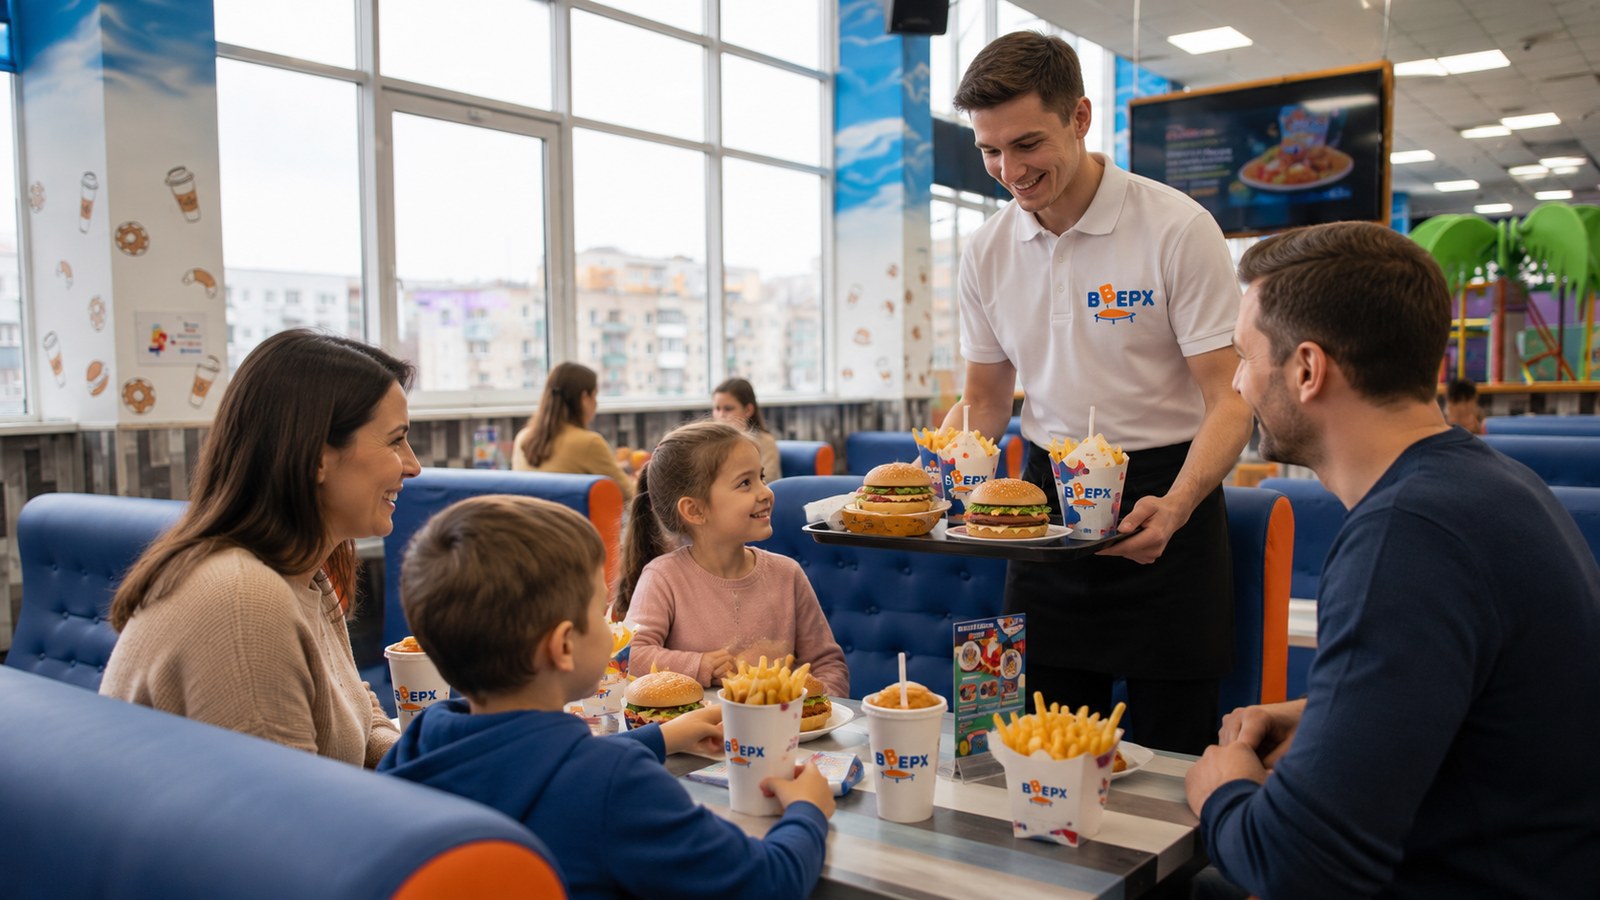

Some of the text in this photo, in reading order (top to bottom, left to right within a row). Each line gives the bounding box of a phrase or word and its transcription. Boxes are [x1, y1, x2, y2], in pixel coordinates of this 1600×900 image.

[1087, 283, 1155, 308] ВВЕРХ
[1064, 482, 1112, 499] ВВЕРХ
[725, 738, 765, 758] ВВЕРХ
[875, 748, 929, 769] ВВЕРХ
[1021, 780, 1068, 799] ВВЕРХ
